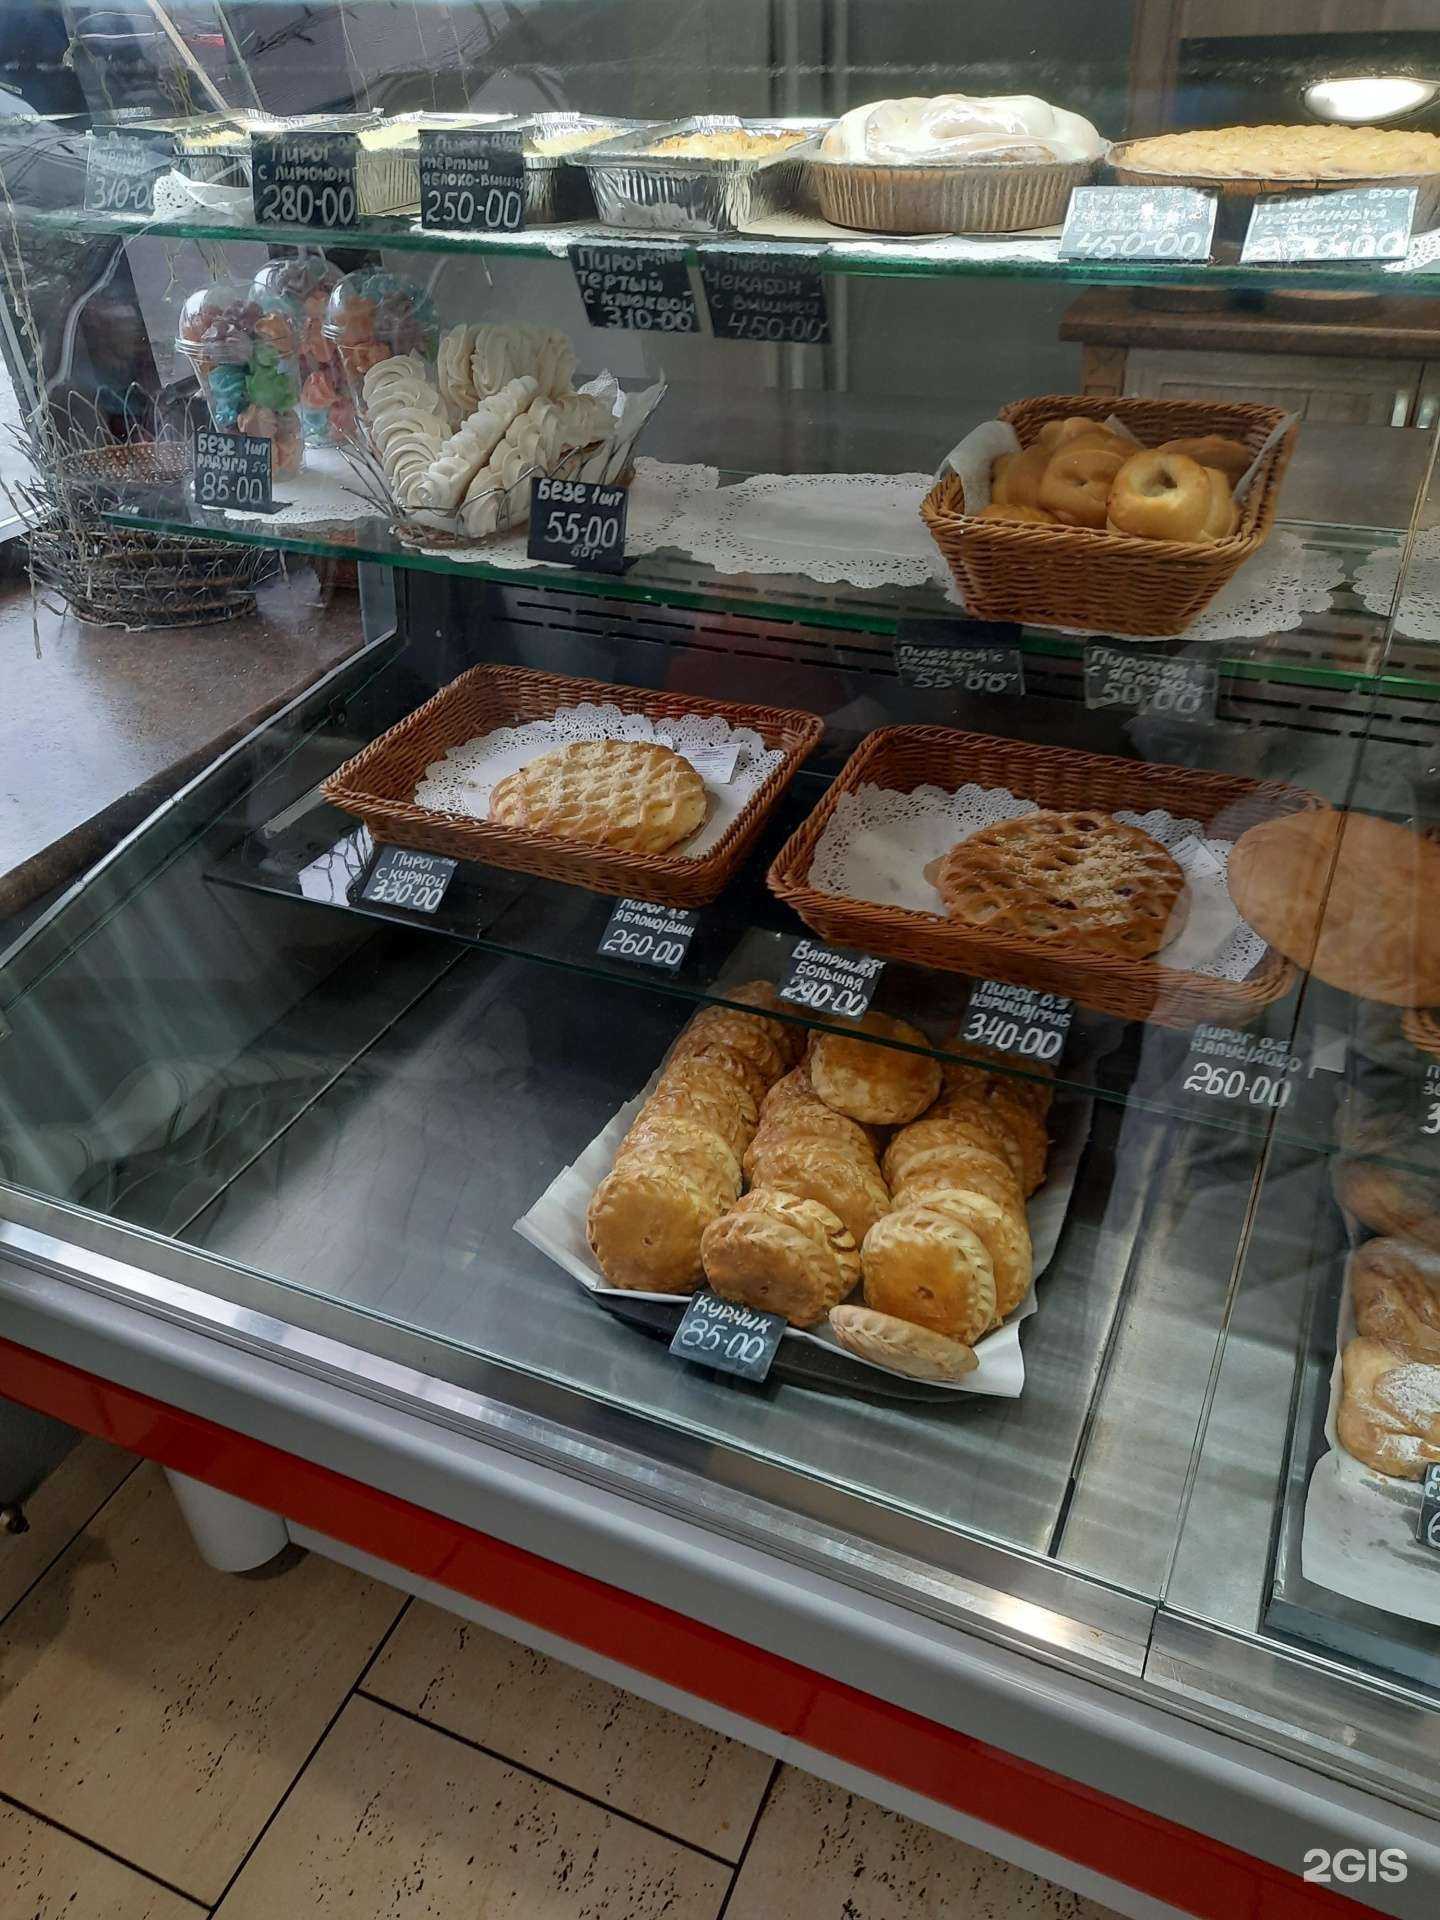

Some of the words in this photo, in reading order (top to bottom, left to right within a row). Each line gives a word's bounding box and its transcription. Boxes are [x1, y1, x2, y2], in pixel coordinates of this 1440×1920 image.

[262, 184, 356, 227] 280-00
[426, 188, 522, 228] 250-00
[1076, 231, 1202, 258] 450-00
[602, 306, 693, 331] 310-00
[727, 312, 834, 342] 450-00
[544, 511, 619, 548] 55-00
[602, 929, 685, 965] 260-00
[962, 1012, 1064, 1060] 340-00
[1182, 1061, 1293, 1108] 260-00
[681, 1317, 766, 1364] 85-00
